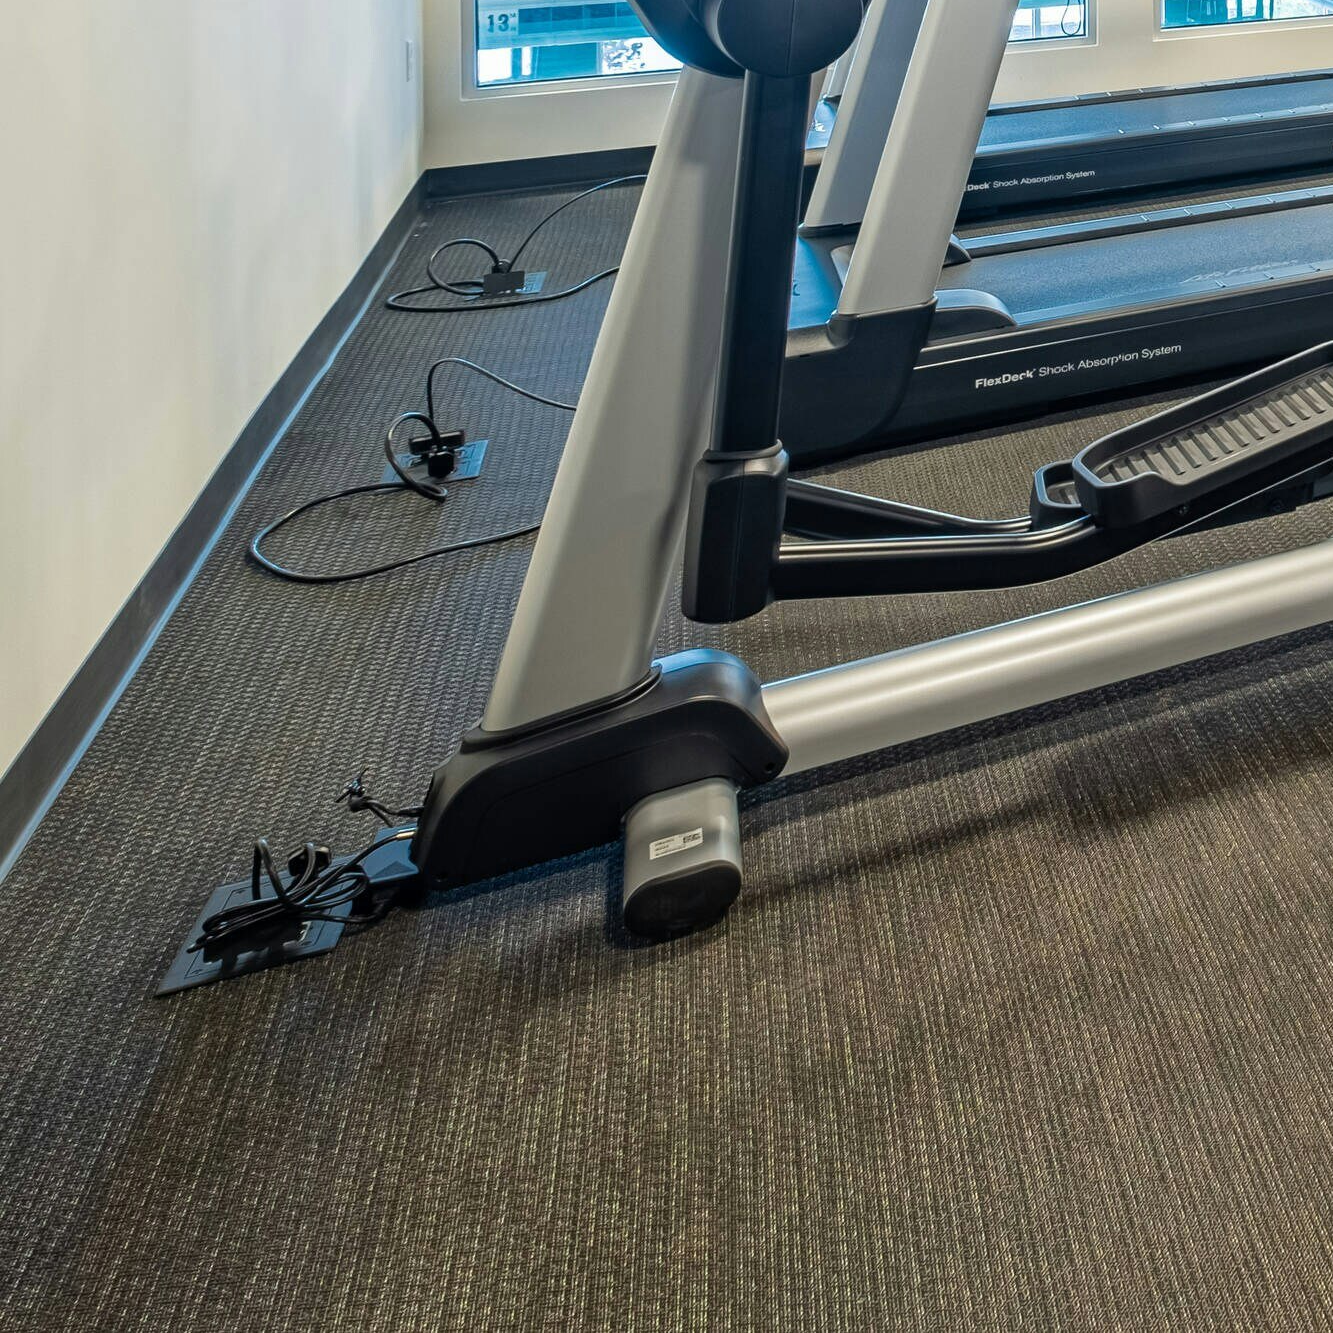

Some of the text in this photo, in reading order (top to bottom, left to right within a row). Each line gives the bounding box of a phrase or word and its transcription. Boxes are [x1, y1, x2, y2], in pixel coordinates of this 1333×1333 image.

[965, 182, 991, 192] Deck
[1066, 169, 1096, 180] System
[1038, 363, 1075, 378] Shock
[1077, 352, 1139, 370] Absorption
[1141, 344, 1183, 360] System
